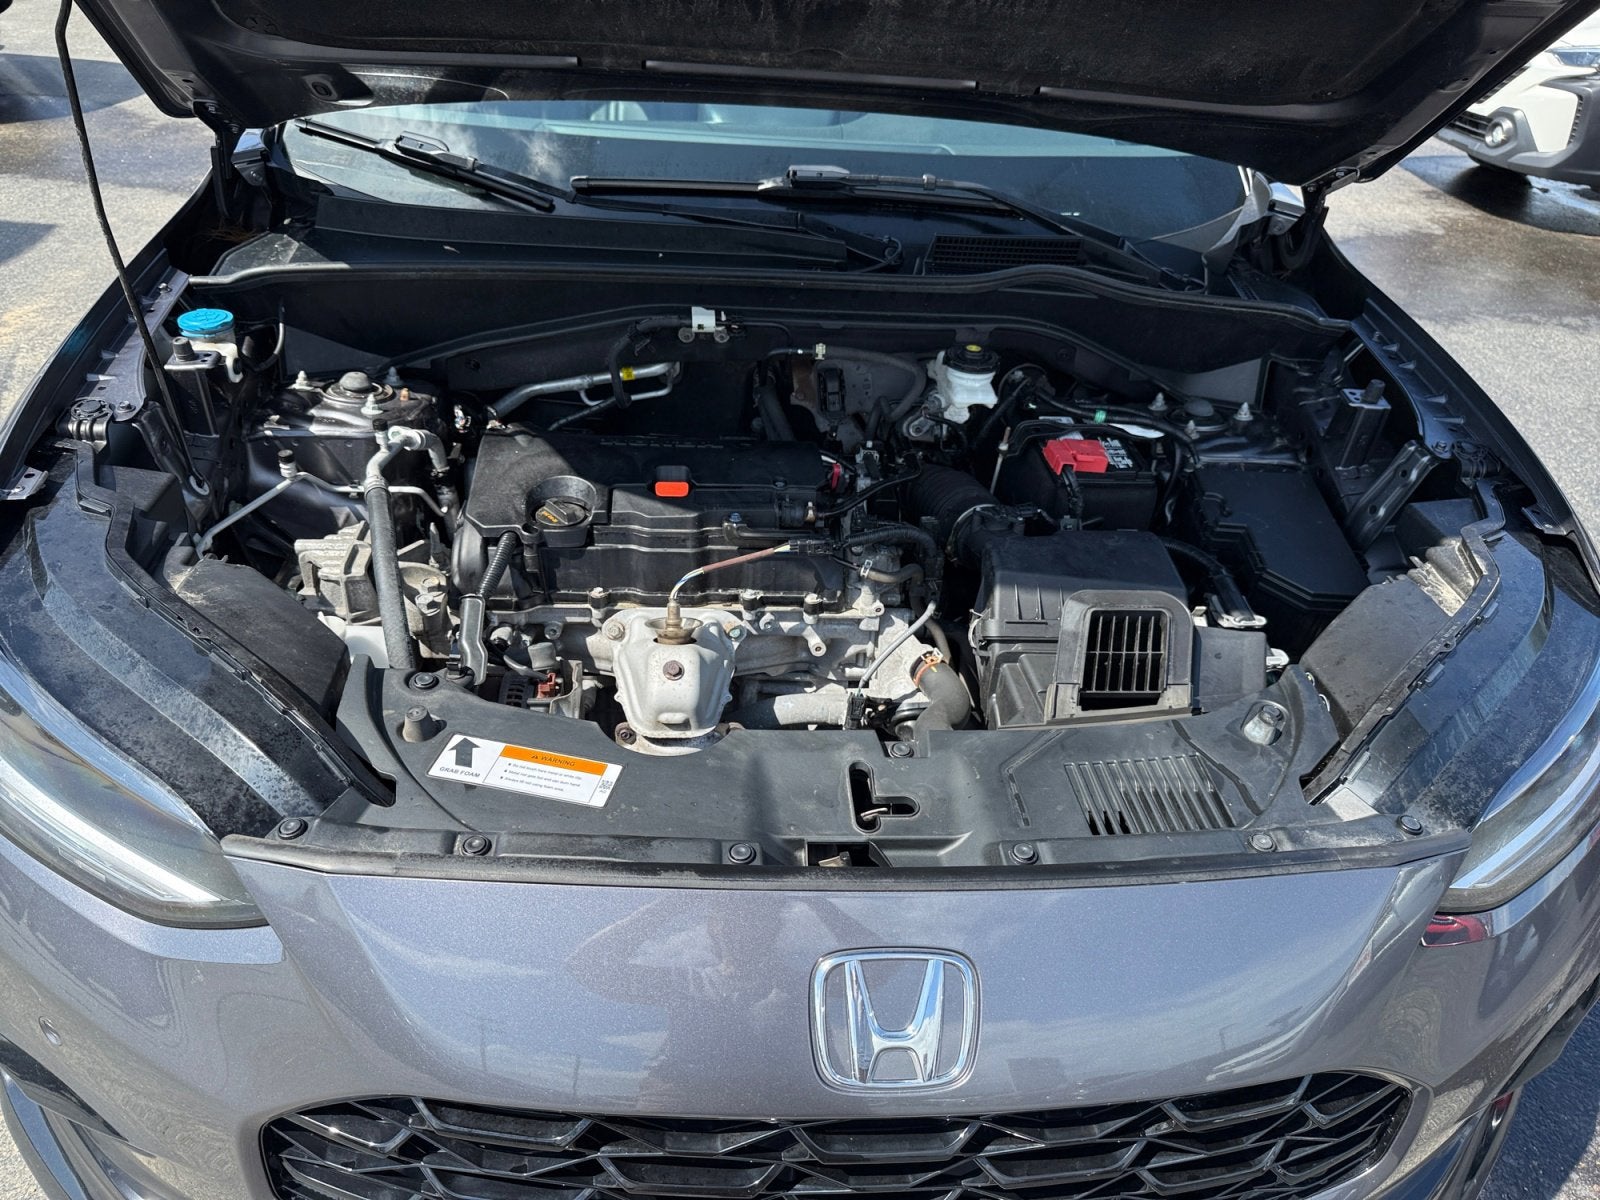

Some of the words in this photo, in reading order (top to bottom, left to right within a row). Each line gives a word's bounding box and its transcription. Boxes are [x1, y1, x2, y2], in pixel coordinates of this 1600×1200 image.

[541, 756, 576, 767] WARNING
[439, 766, 460, 774] GRAB
[460, 770, 480, 778] FOAM
